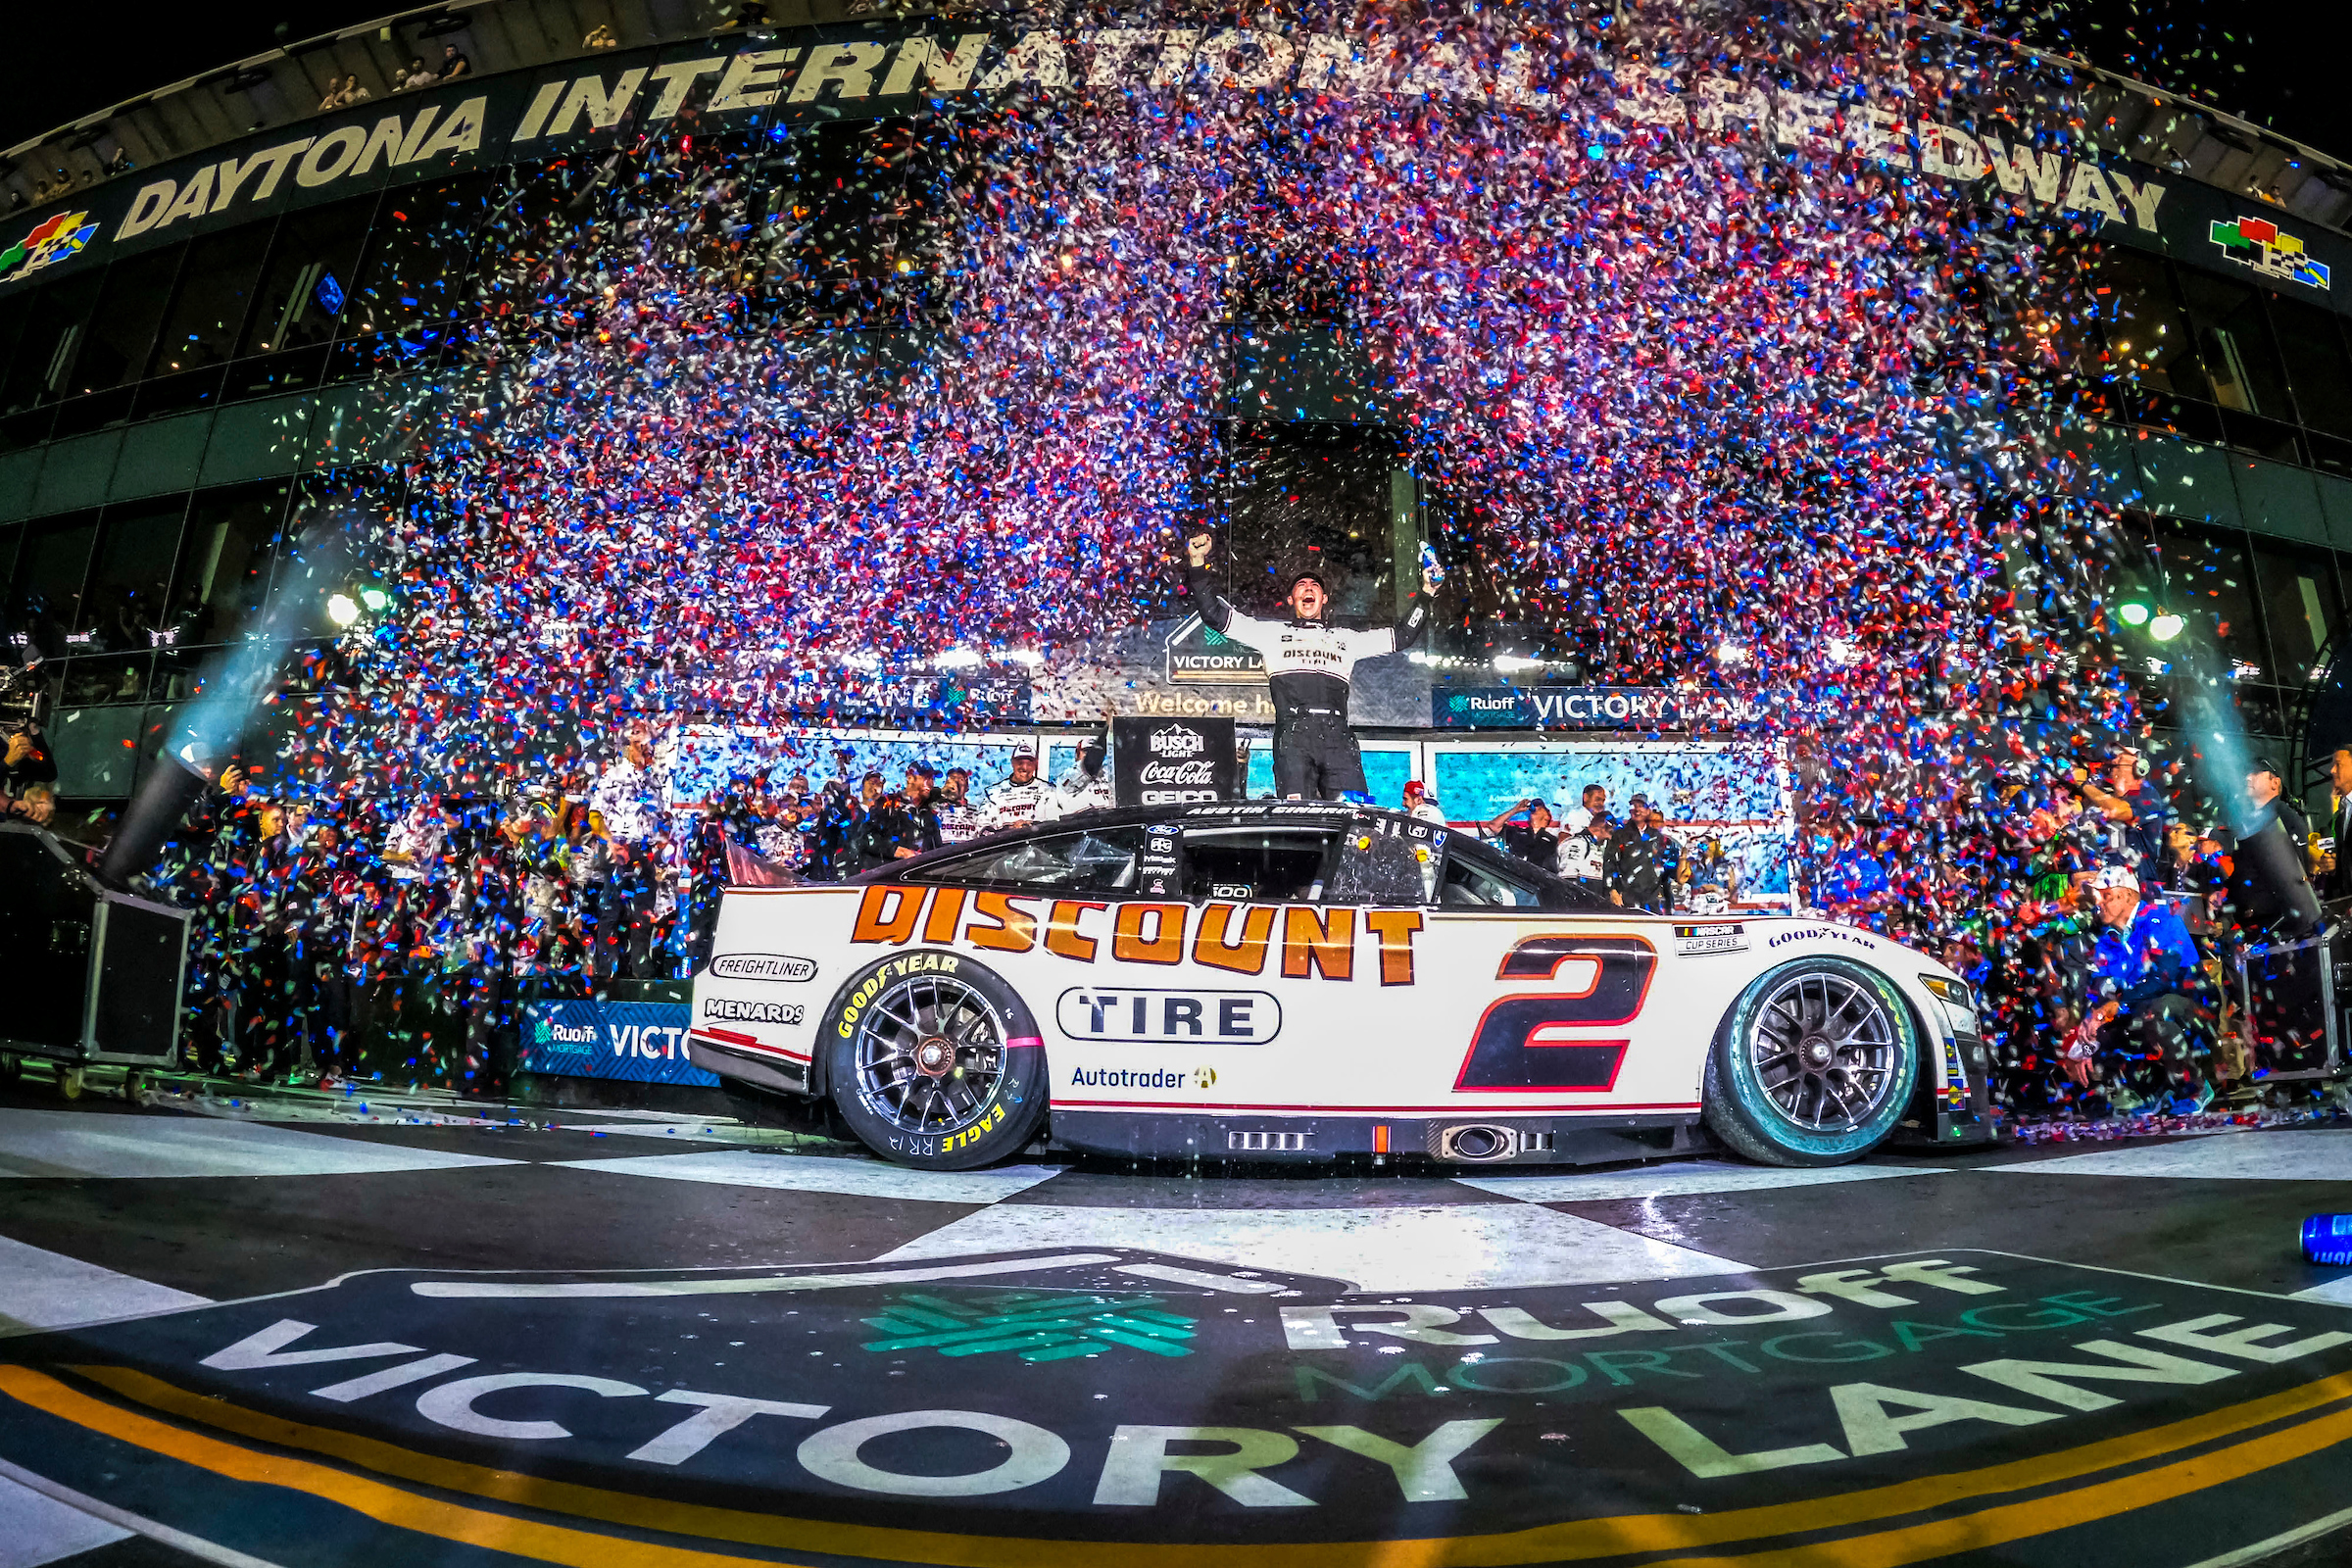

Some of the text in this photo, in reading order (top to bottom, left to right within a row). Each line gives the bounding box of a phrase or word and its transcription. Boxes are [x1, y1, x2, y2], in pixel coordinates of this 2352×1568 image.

[114, 95, 488, 242] DAYTONA
[1173, 656, 1245, 669] VICTORY
[1135, 692, 1249, 713] Welcome
[1470, 694, 1515, 710] Ruoff
[1532, 693, 1668, 719] VICTORY
[1150, 735, 1204, 752] BUSCH
[1141, 790, 1218, 806] GEICO
[1186, 806, 1268, 815] AUSTIN
[850, 884, 1425, 987] DISCOUNT
[1686, 939, 1738, 950] CUP SERIES
[1768, 927, 1876, 950] GOODYEAR
[718, 959, 809, 977] FREIGHTLINER
[838, 954, 959, 1039] GOODYEAR
[705, 999, 805, 1025] MENARDS
[1079, 996, 1254, 1037] TIRE
[1453, 933, 1659, 1093] 2
[552, 1023, 596, 1043] Ruoff
[549, 1043, 593, 1055] MORTGAGE
[1071, 1066, 1186, 1089] Autotrader
[941, 1102, 1006, 1152] EAGLE
[1294, 1290, 2162, 1403] MORTGAGE
[198, 1312, 2352, 1508] VICTORY LANE
